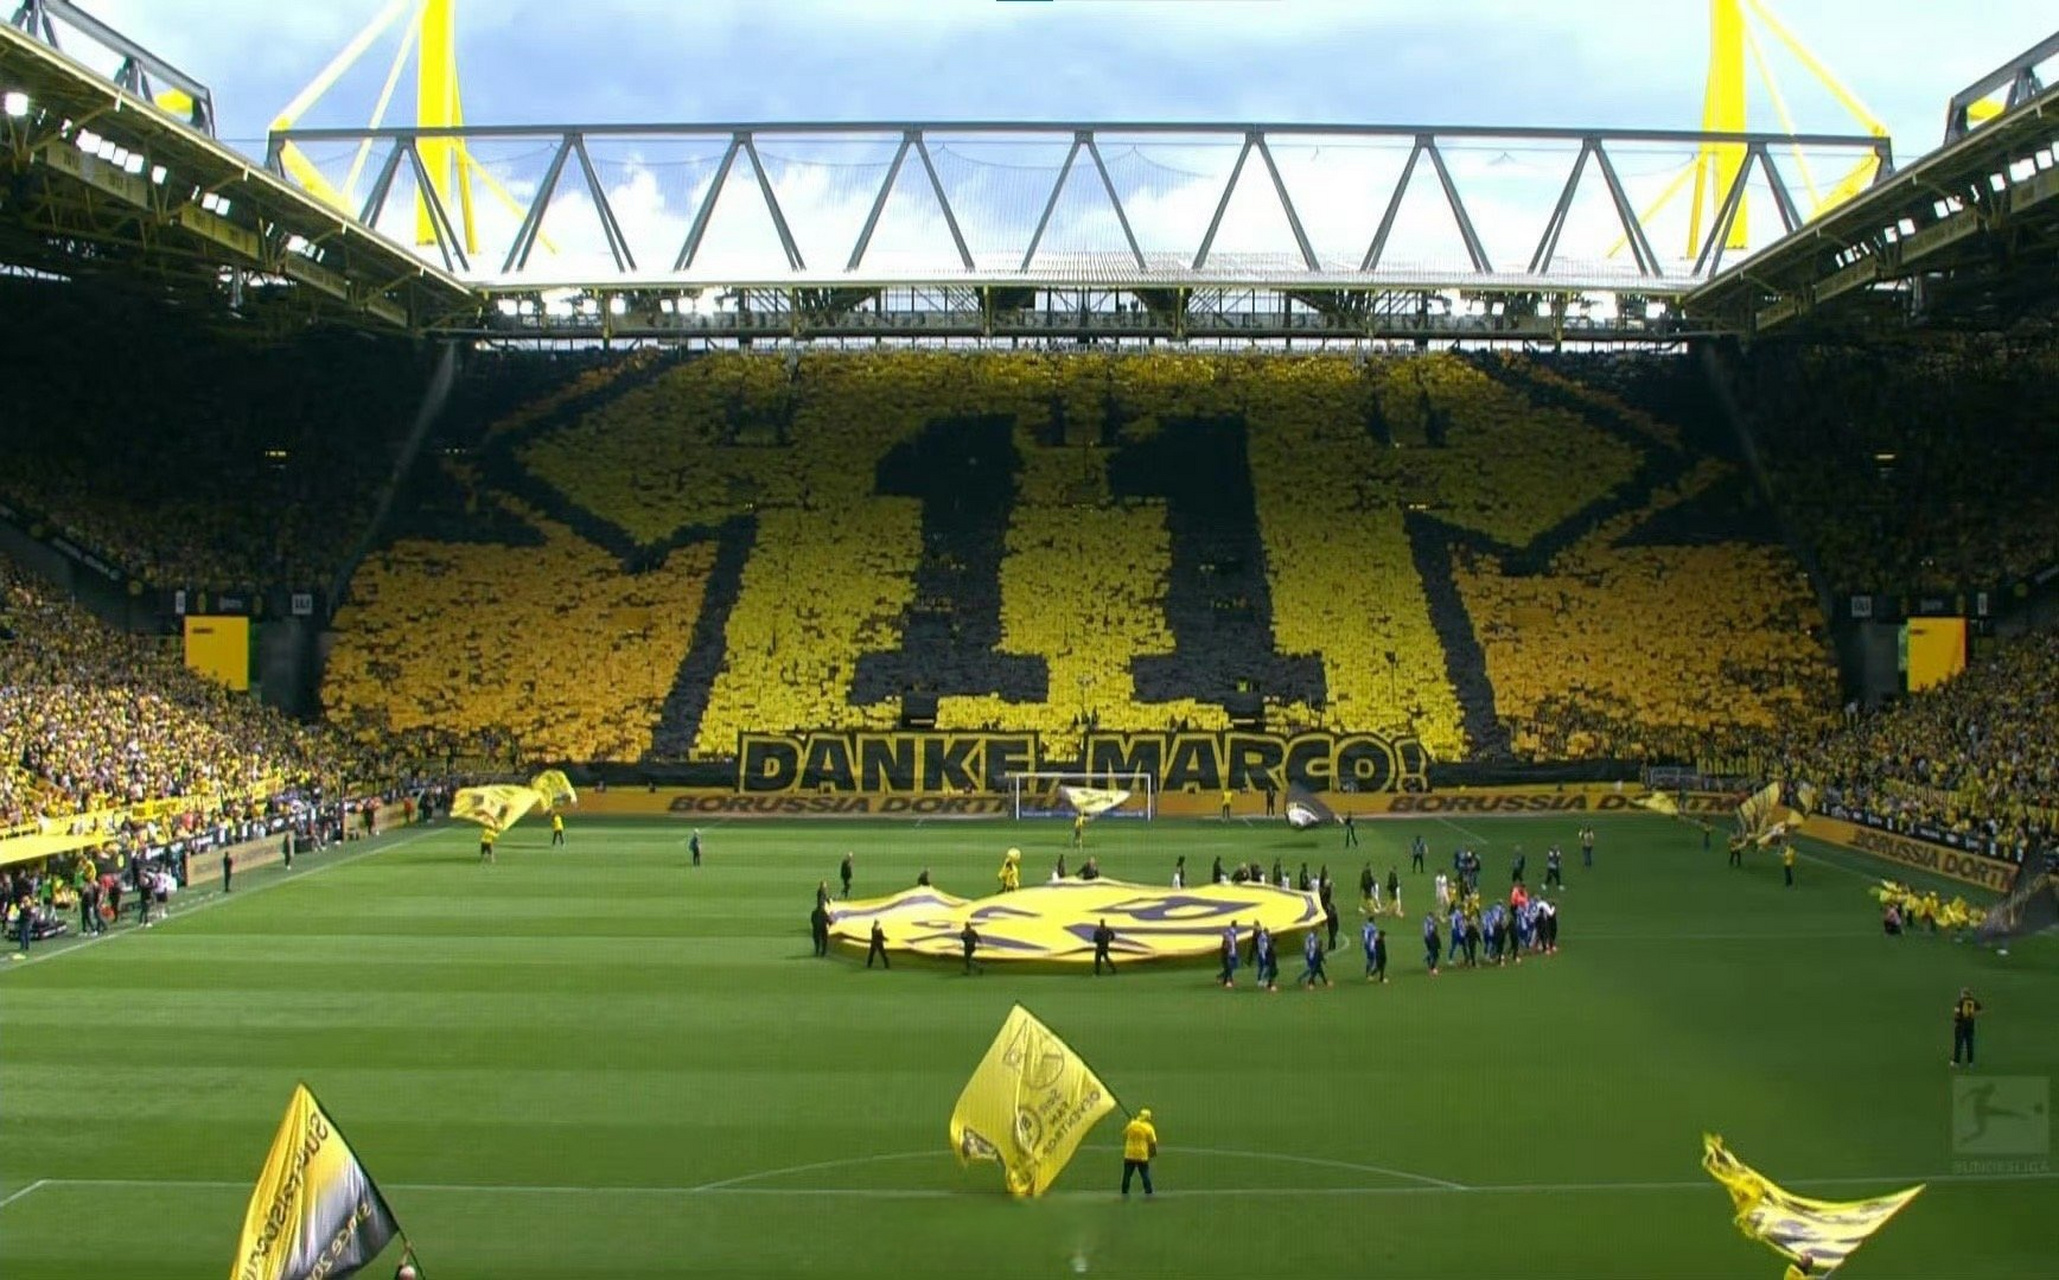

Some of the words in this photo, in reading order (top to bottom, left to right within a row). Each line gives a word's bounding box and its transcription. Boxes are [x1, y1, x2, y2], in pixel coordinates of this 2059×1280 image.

[742, 733, 1037, 793] DANKE
[1086, 733, 1429, 793] MARCO!
[669, 795, 869, 813] BORUSSIA
[1387, 794, 1587, 813] BORUSSIA
[1856, 827, 1938, 869] BORUSSIA
